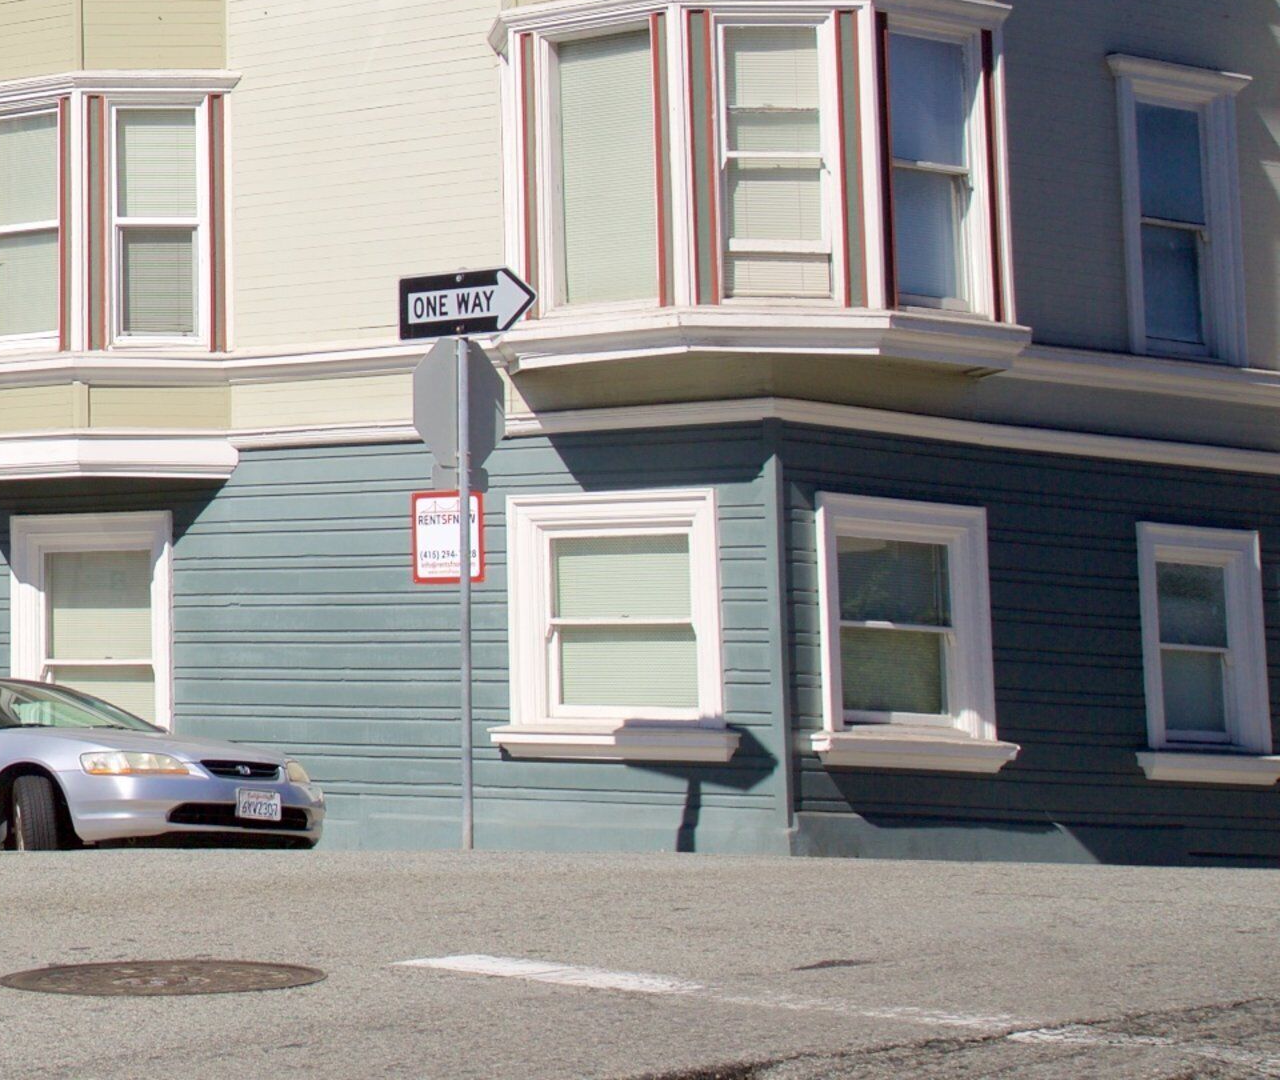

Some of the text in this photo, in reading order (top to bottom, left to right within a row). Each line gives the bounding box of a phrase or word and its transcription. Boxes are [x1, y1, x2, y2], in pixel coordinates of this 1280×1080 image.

[413, 289, 495, 320] ONE WAY
[418, 513, 476, 526] RENTSFNW
